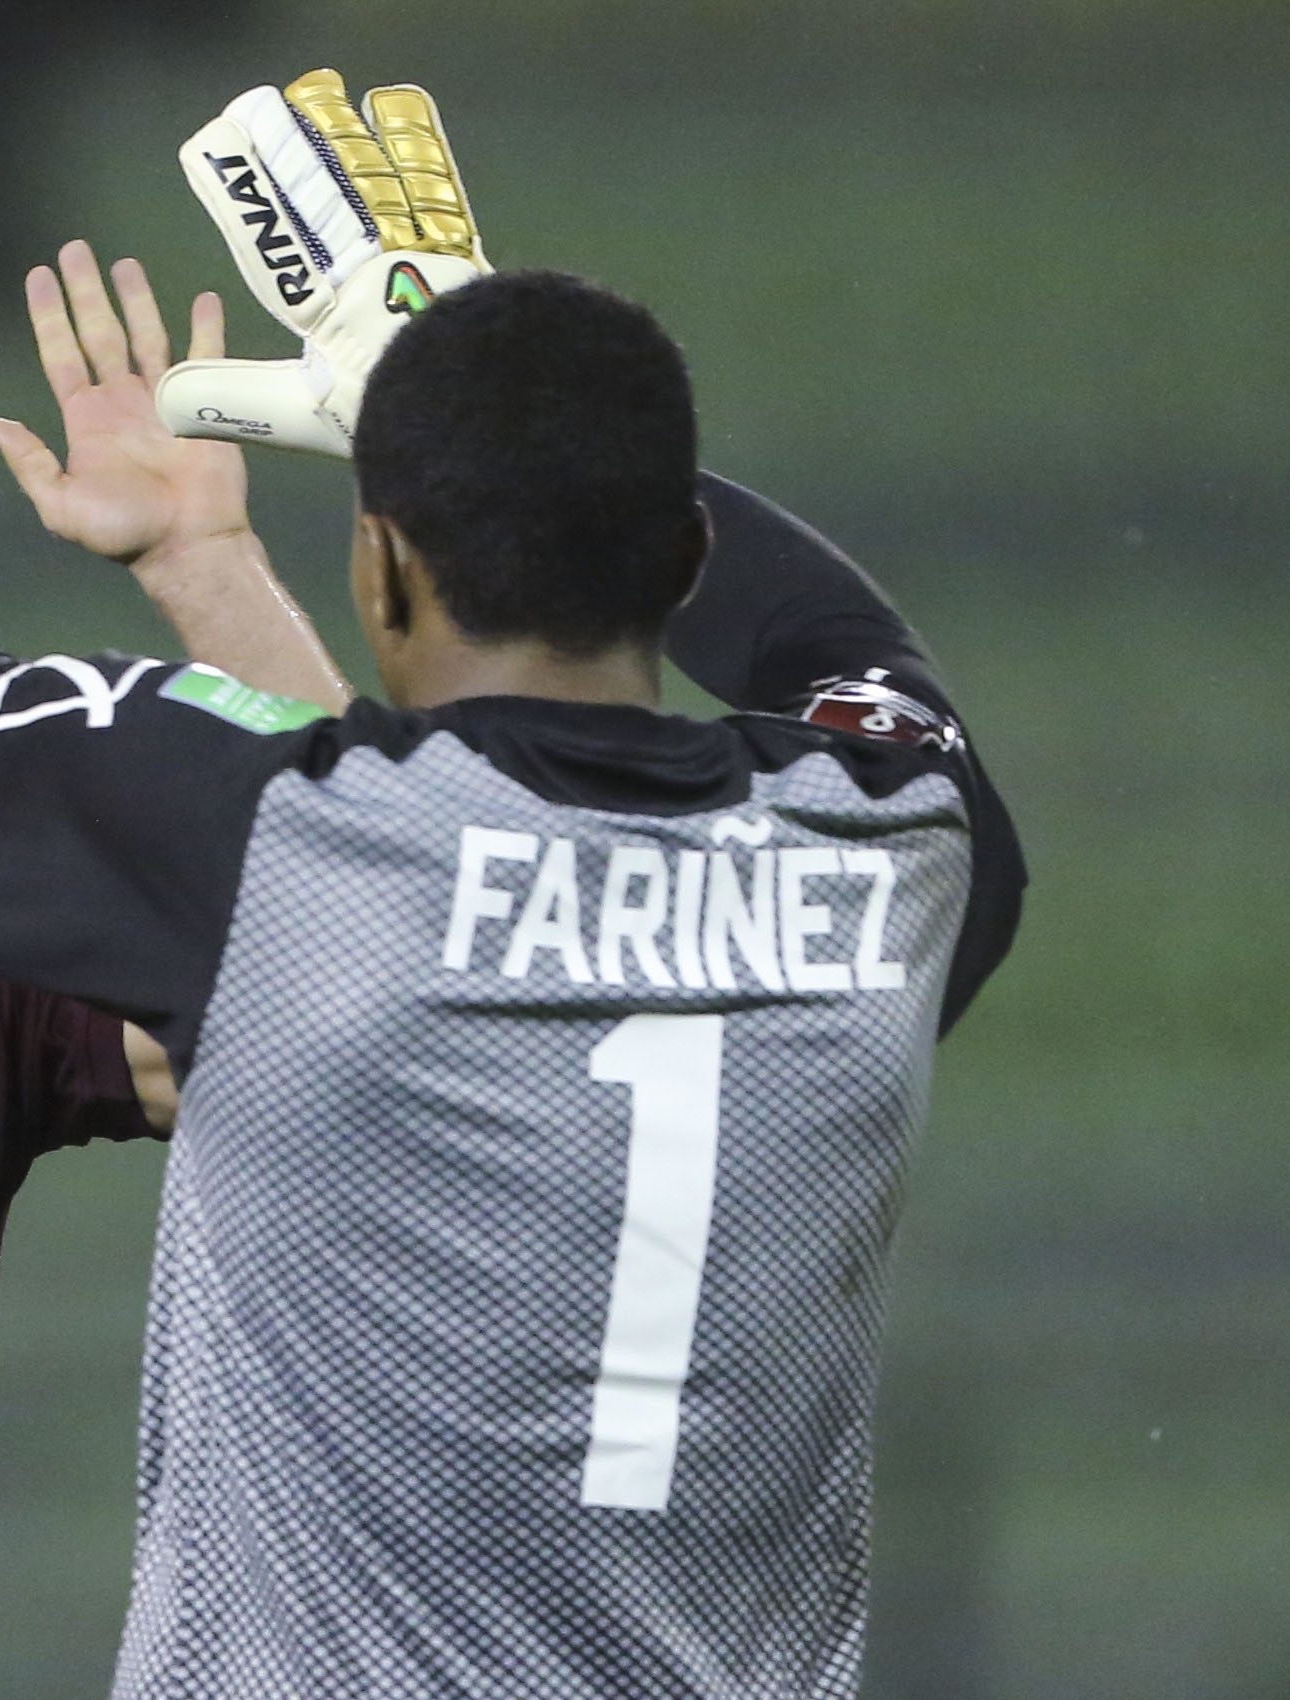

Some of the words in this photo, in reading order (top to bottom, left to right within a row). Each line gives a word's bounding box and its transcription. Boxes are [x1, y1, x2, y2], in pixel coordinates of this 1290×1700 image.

[203, 152, 315, 306] RINAT
[442, 815, 907, 992] FARIÑEZ
[579, 1012, 723, 1512] 1
